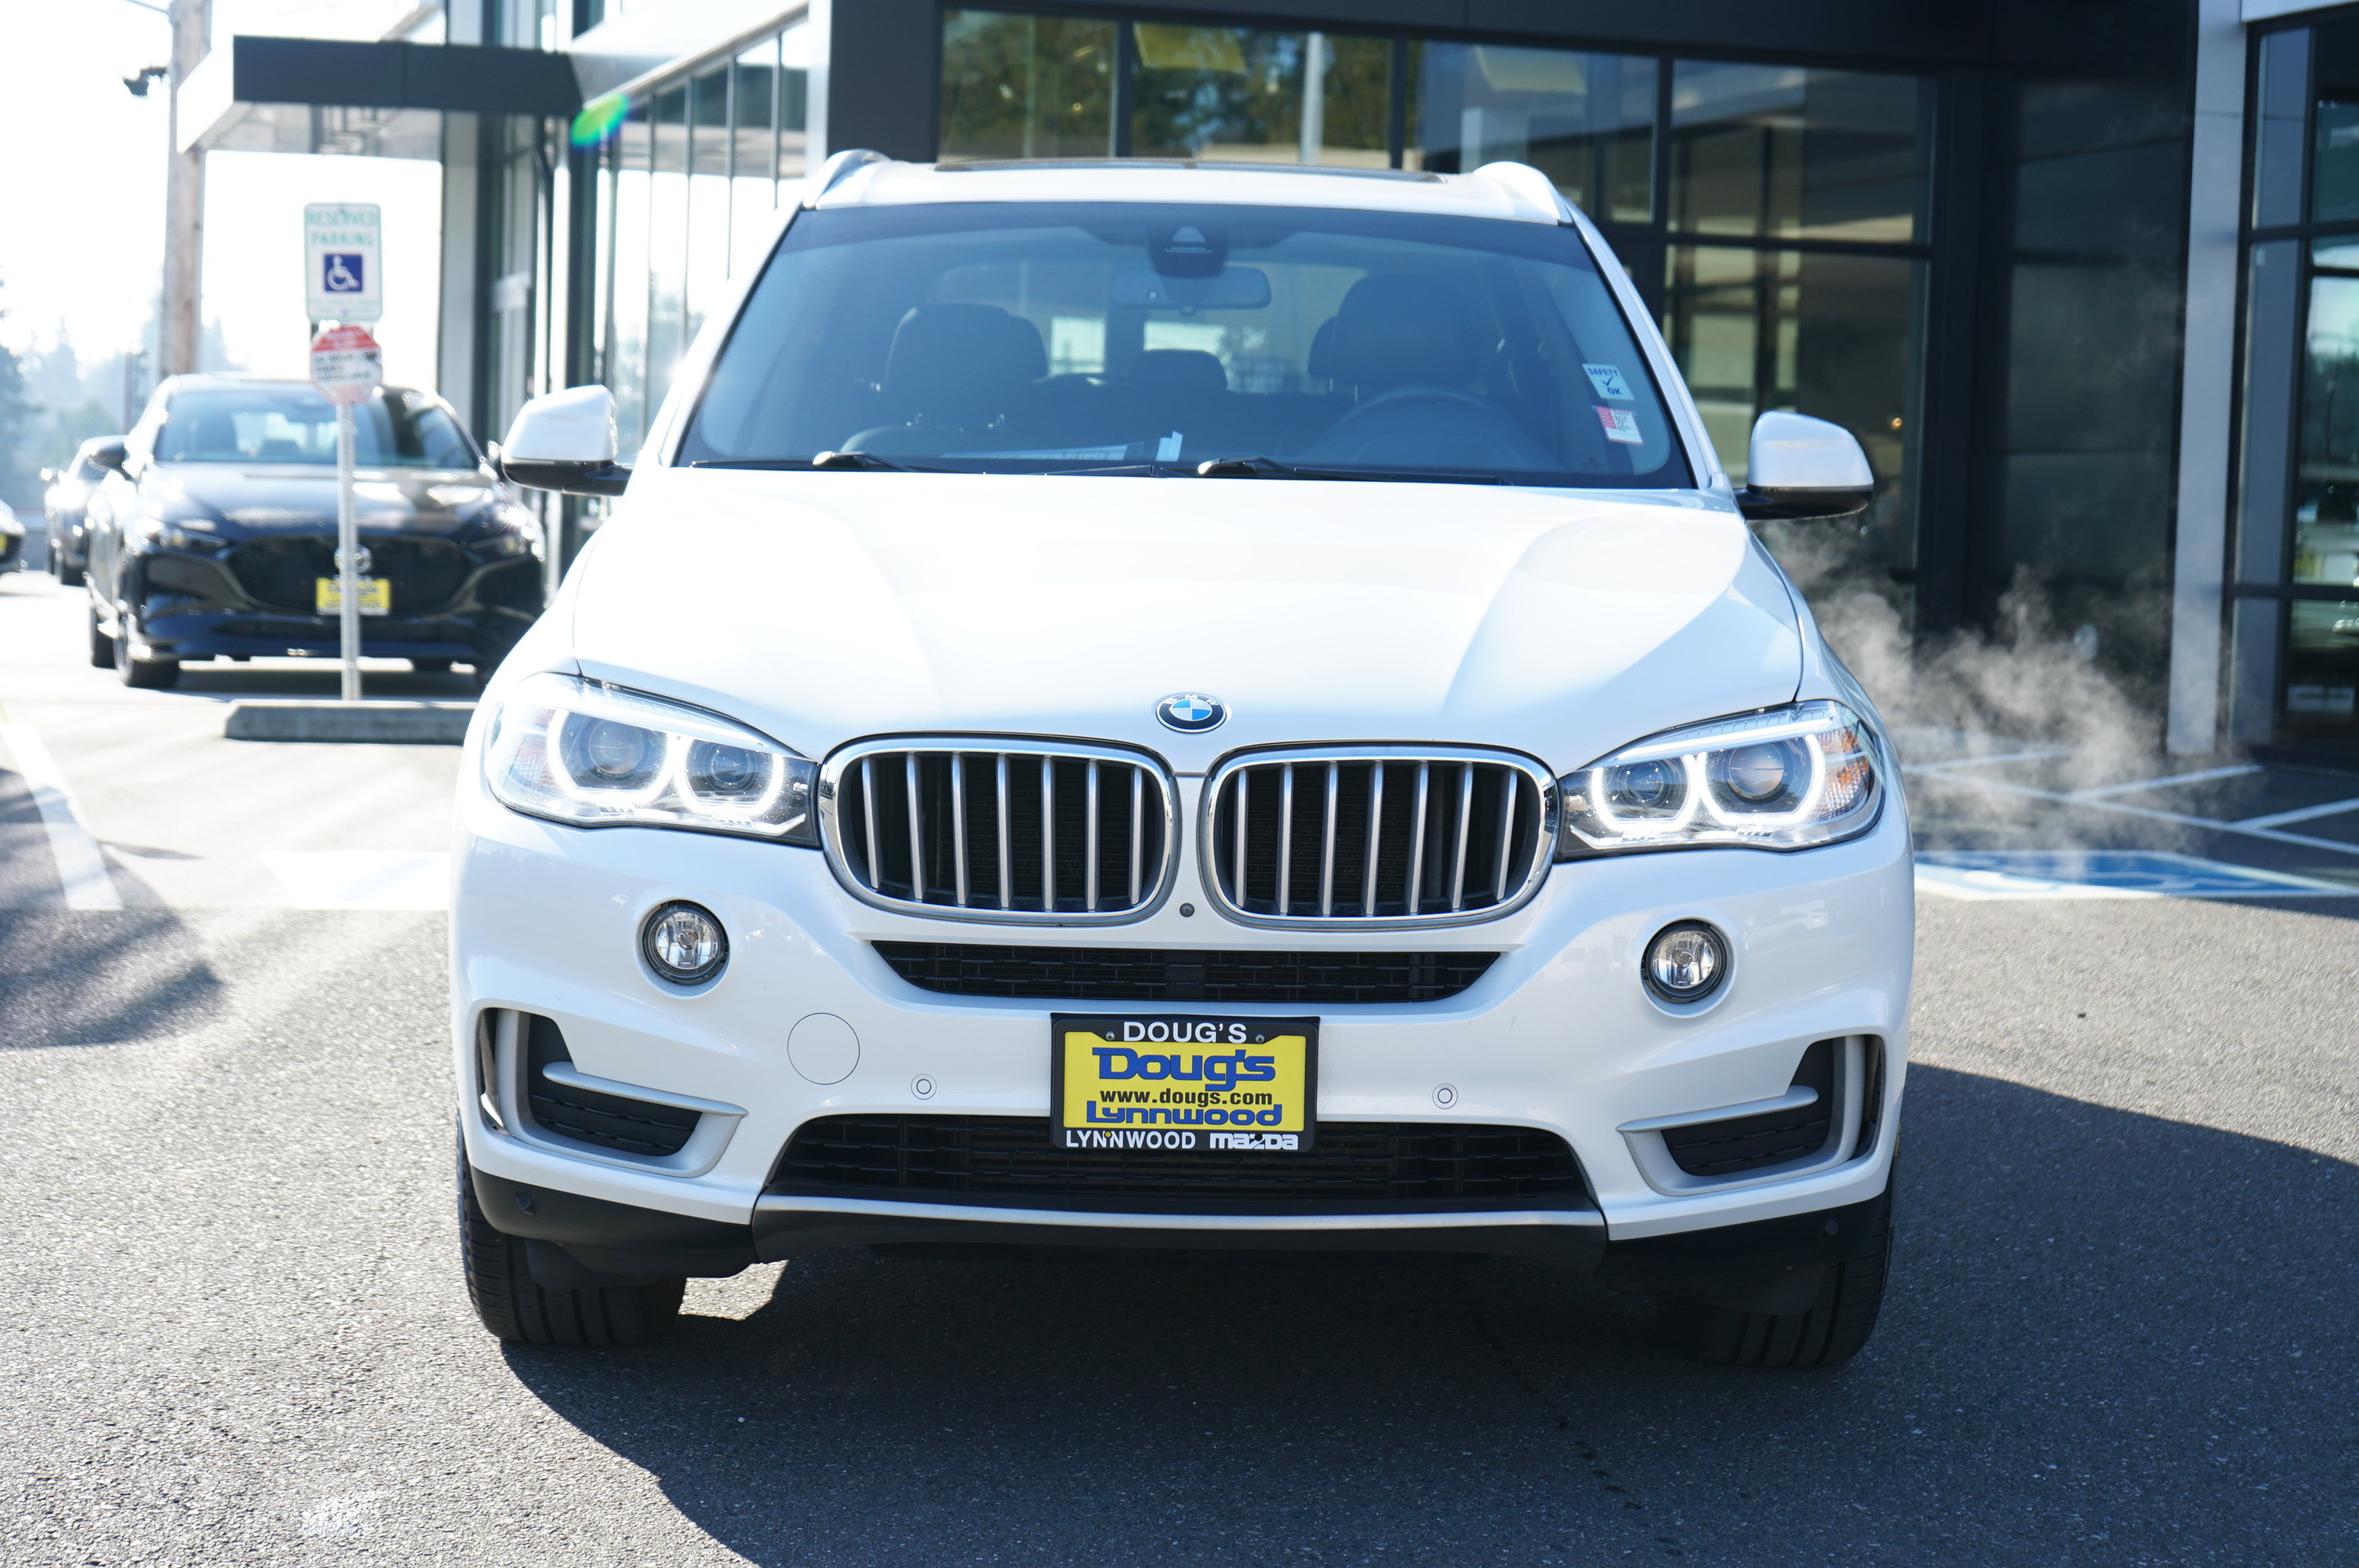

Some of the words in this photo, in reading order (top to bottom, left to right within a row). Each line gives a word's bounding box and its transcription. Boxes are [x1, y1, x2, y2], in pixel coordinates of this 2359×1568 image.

[311, 232, 374, 246] PARKING
[1587, 368, 1618, 377] SAFETY
[1161, 694, 1220, 706] BMW
[1124, 1022, 1247, 1044] DOUG'S
[1100, 1088, 1273, 1108] www.dougs.com
[1086, 1101, 1283, 1127] Lynnwood
[1066, 1130, 1196, 1149] LYNNWOOD
